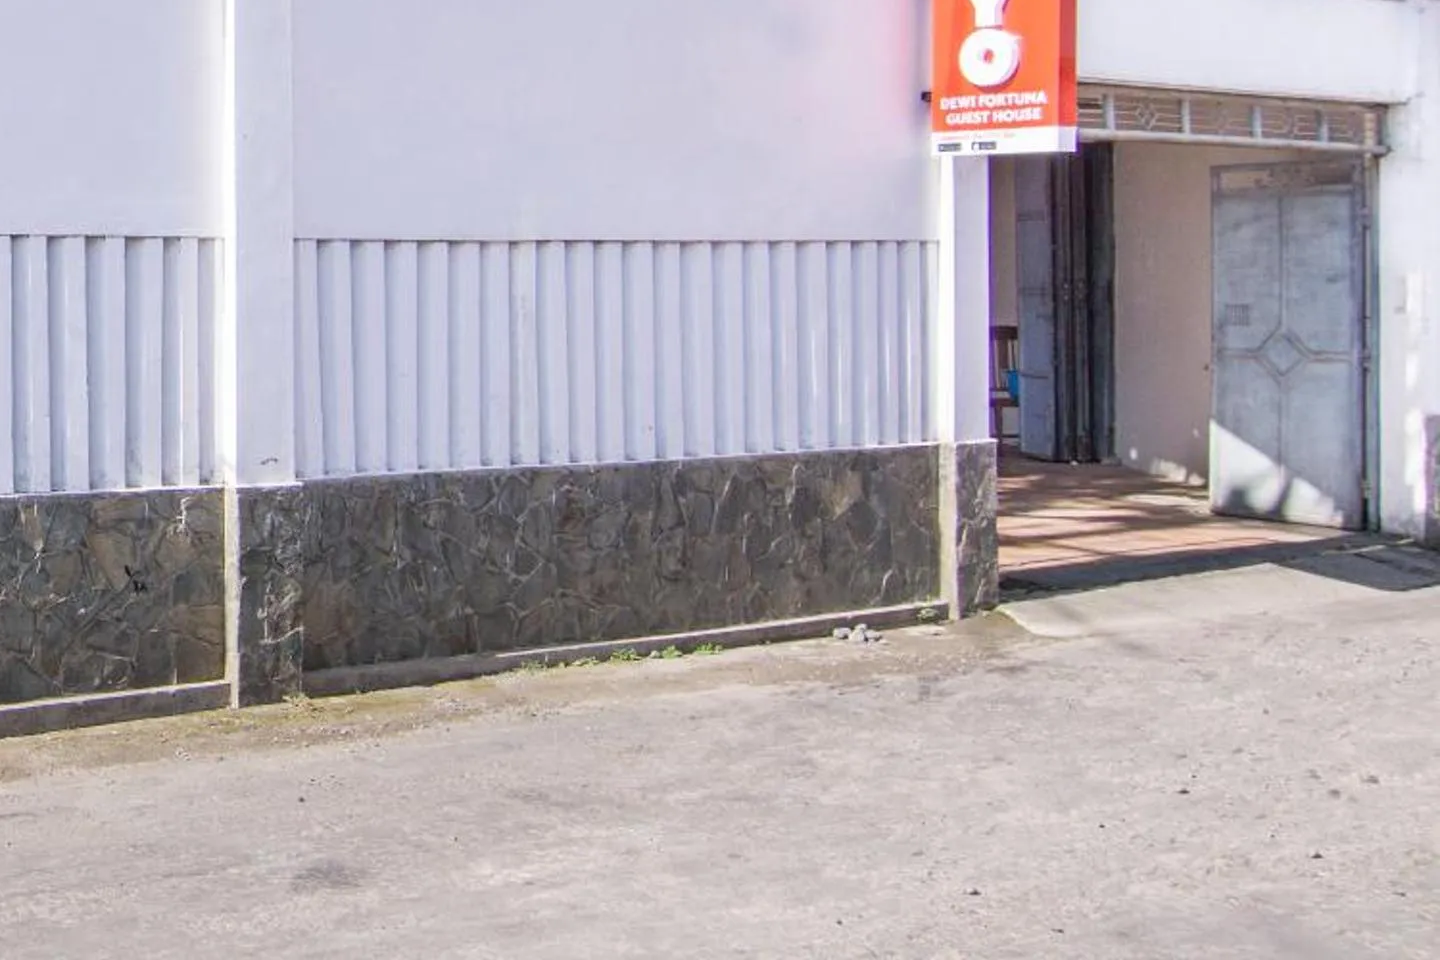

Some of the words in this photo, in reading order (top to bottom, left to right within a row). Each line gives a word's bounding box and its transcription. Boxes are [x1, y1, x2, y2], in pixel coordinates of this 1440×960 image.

[940, 96, 976, 110] DEWI
[979, 90, 1048, 108] FORTUNA
[946, 111, 990, 125] GUEST
[992, 107, 1042, 122] HOUSE
